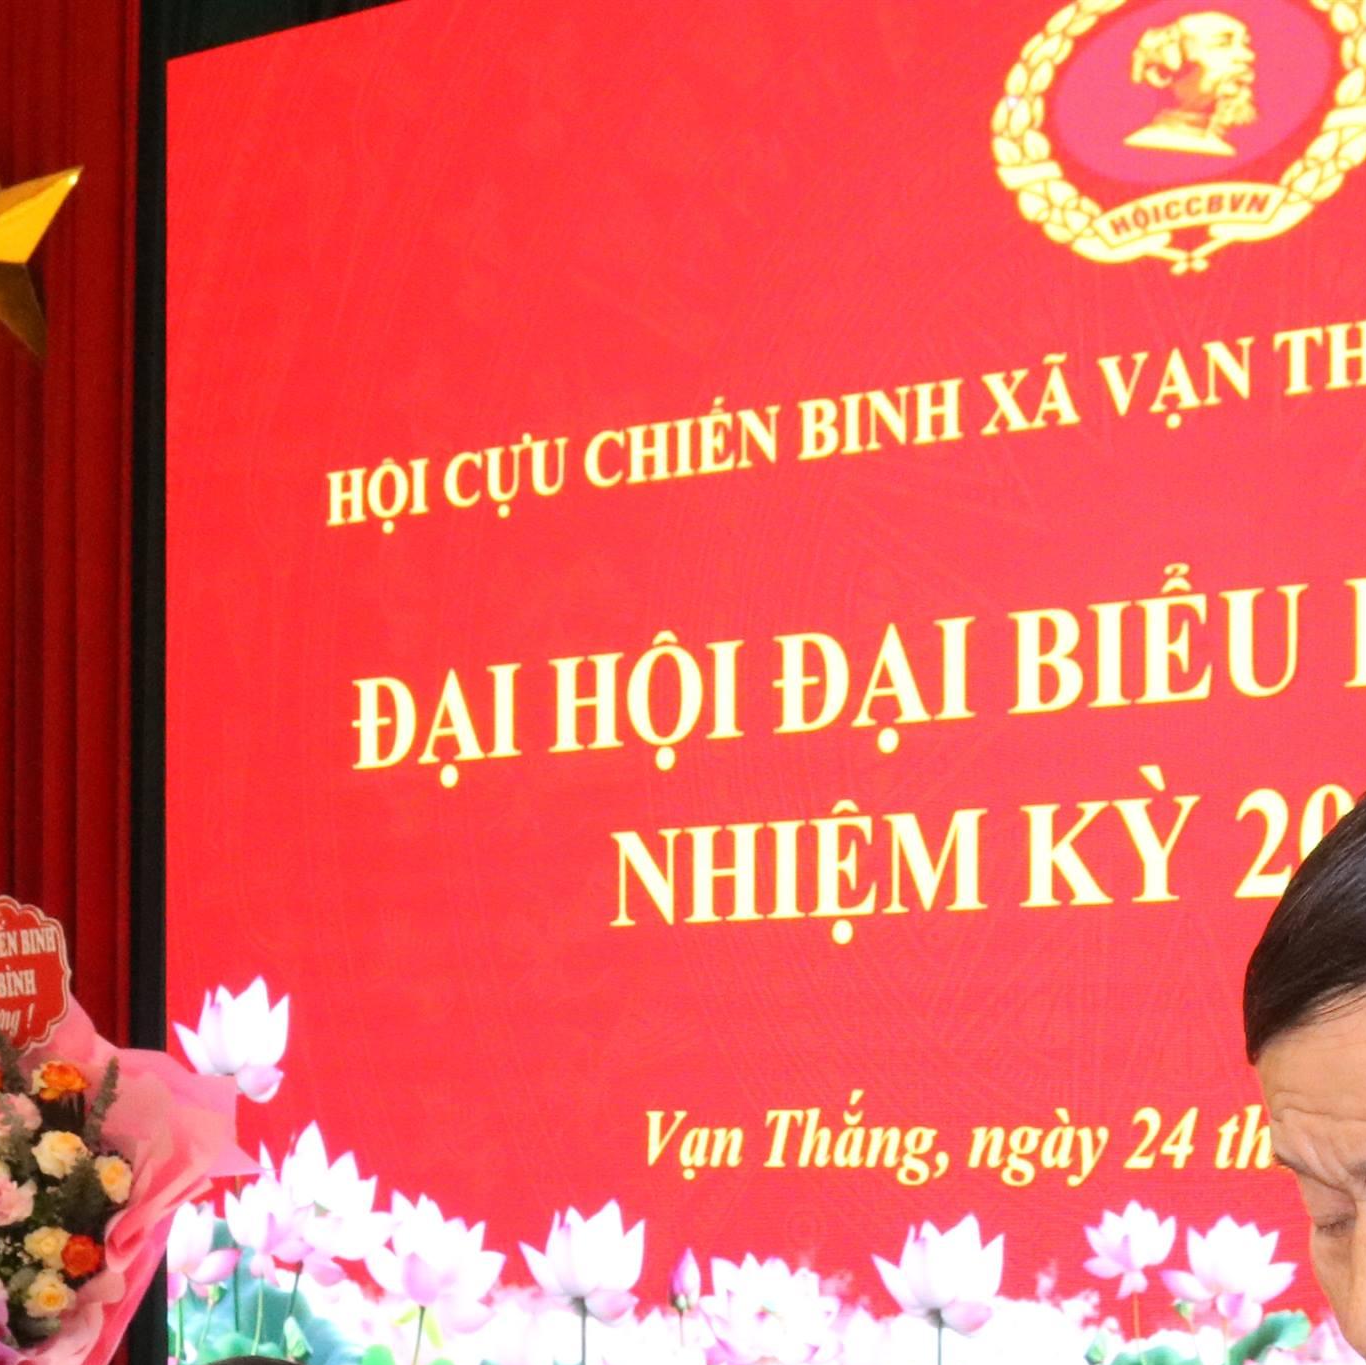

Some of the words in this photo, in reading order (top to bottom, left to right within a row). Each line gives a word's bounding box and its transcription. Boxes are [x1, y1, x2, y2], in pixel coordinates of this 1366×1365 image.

[327, 458, 429, 534] HỘI
[444, 433, 568, 518] CỰU
[584, 397, 780, 488] CHIẾN
[798, 378, 963, 460] BINH
[981, 353, 1081, 436] XÃ
[1097, 336, 1254, 429] VẠN
[352, 665, 521, 788] ĐẠI
[549, 630, 744, 771] HỘI
[772, 618, 975, 754] ĐẠI
[1008, 563, 1308, 714] BIỂU
[21, 927, 57, 955] BINH
[610, 799, 987, 944] NHIỆM
[1019, 764, 1200, 908] KỲ
[646, 1111, 743, 1180] Vạn
[764, 1089, 949, 1186] Thắng,
[968, 1108, 1109, 1187] ngày
[1123, 1107, 1198, 1169] 24
